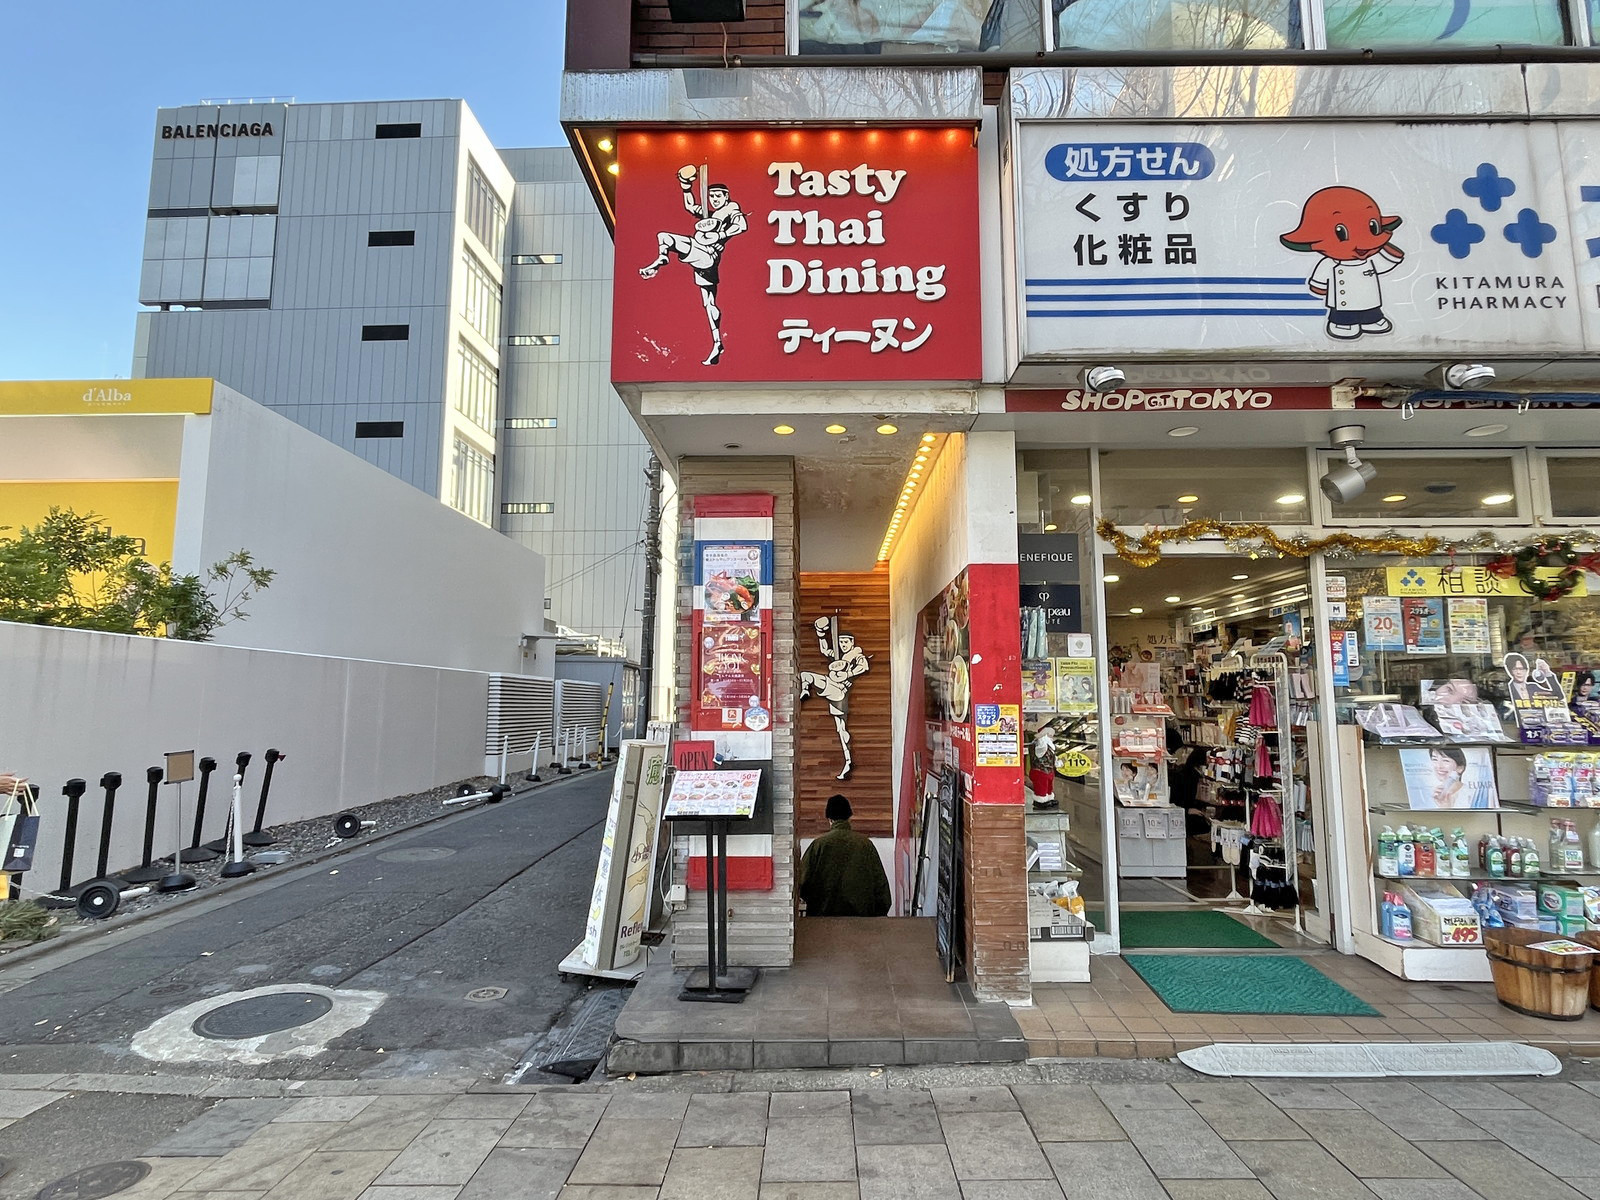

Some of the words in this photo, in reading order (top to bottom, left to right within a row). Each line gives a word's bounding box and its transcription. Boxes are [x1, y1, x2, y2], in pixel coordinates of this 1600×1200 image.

[161, 122, 274, 139] BALENCIAGA
[1064, 146, 1200, 178] 処方せん
[767, 161, 907, 202] Tasty
[1075, 192, 1190, 222] くすり
[767, 210, 886, 245] Thai
[1073, 233, 1197, 266] 化粧品
[765, 258, 947, 302] Dining
[1436, 276, 1565, 290] KITAMURA
[1438, 296, 1567, 310] PHARMACY
[777, 317, 933, 354] ティーヌン
[82, 387, 132, 402] d'Alba
[1061, 388, 1146, 412] SHOP
[1174, 388, 1273, 411] TOKYO
[1020, 553, 1074, 562] ENEFIQUE
[1047, 608, 1071, 619] peau
[1374, 616, 1393, 630] 20
[680, 752, 709, 770] OPEN
[1452, 927, 1478, 943] 495
